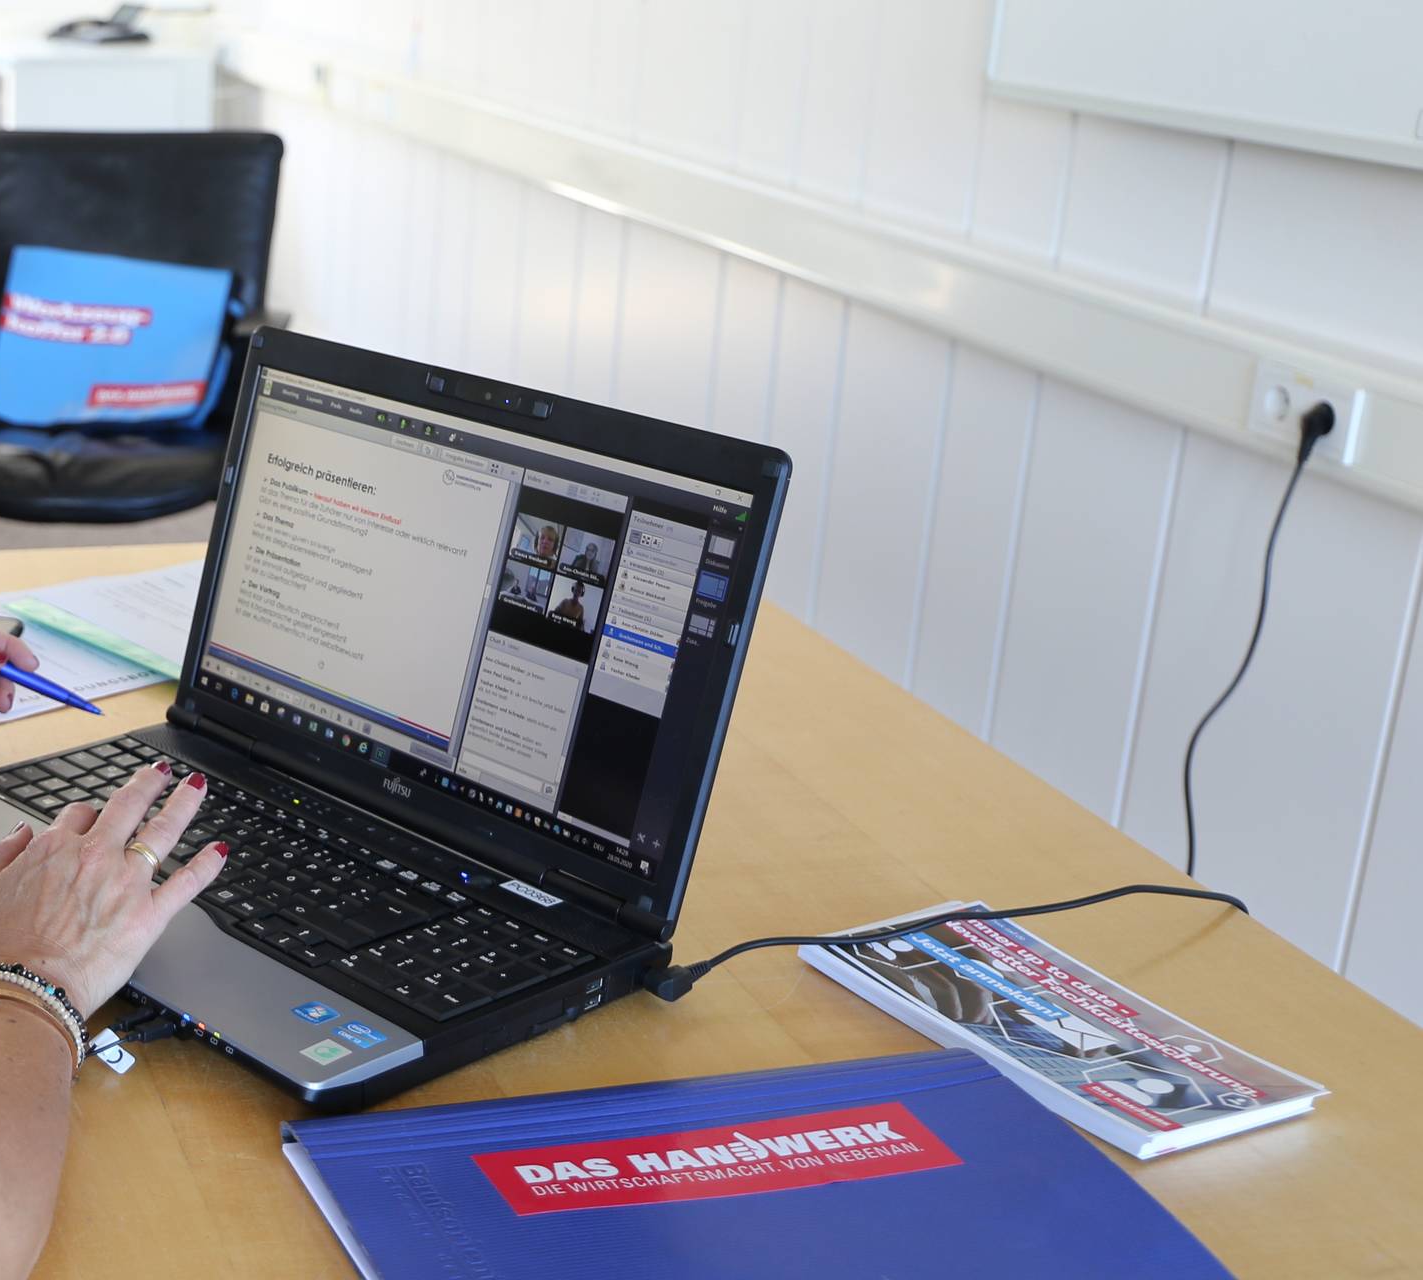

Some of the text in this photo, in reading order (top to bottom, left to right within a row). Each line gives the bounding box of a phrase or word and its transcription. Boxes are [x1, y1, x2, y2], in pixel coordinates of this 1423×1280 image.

[266, 452, 377, 498] Erfolgreich präsentieren:
[269, 477, 281, 487] Das
[281, 481, 308, 496] Publikum
[712, 503, 728, 514] Hilfe
[274, 516, 294, 528] Thema
[633, 515, 664, 529] Teilnehmer
[395, 527, 410, 540] oder
[411, 533, 434, 548] wirklich
[265, 549, 301, 567] Präsentation
[258, 583, 280, 598] Vortrag
[383, 777, 412, 798] FUJITSU
[593, 841, 604, 852] DEU
[911, 935, 1063, 1019] Jetzt anmelden!
[1017, 949, 1045, 965] up
[1046, 965, 1069, 980] to
[1071, 977, 1117, 1006] date
[1039, 977, 1258, 1098] Fachkräftesicherung.
[513, 1120, 907, 1185] DAS HANDWERK
[530, 1141, 926, 1197] DIE WIRTSCHAFTSMACHT. VON NEBENAN.
